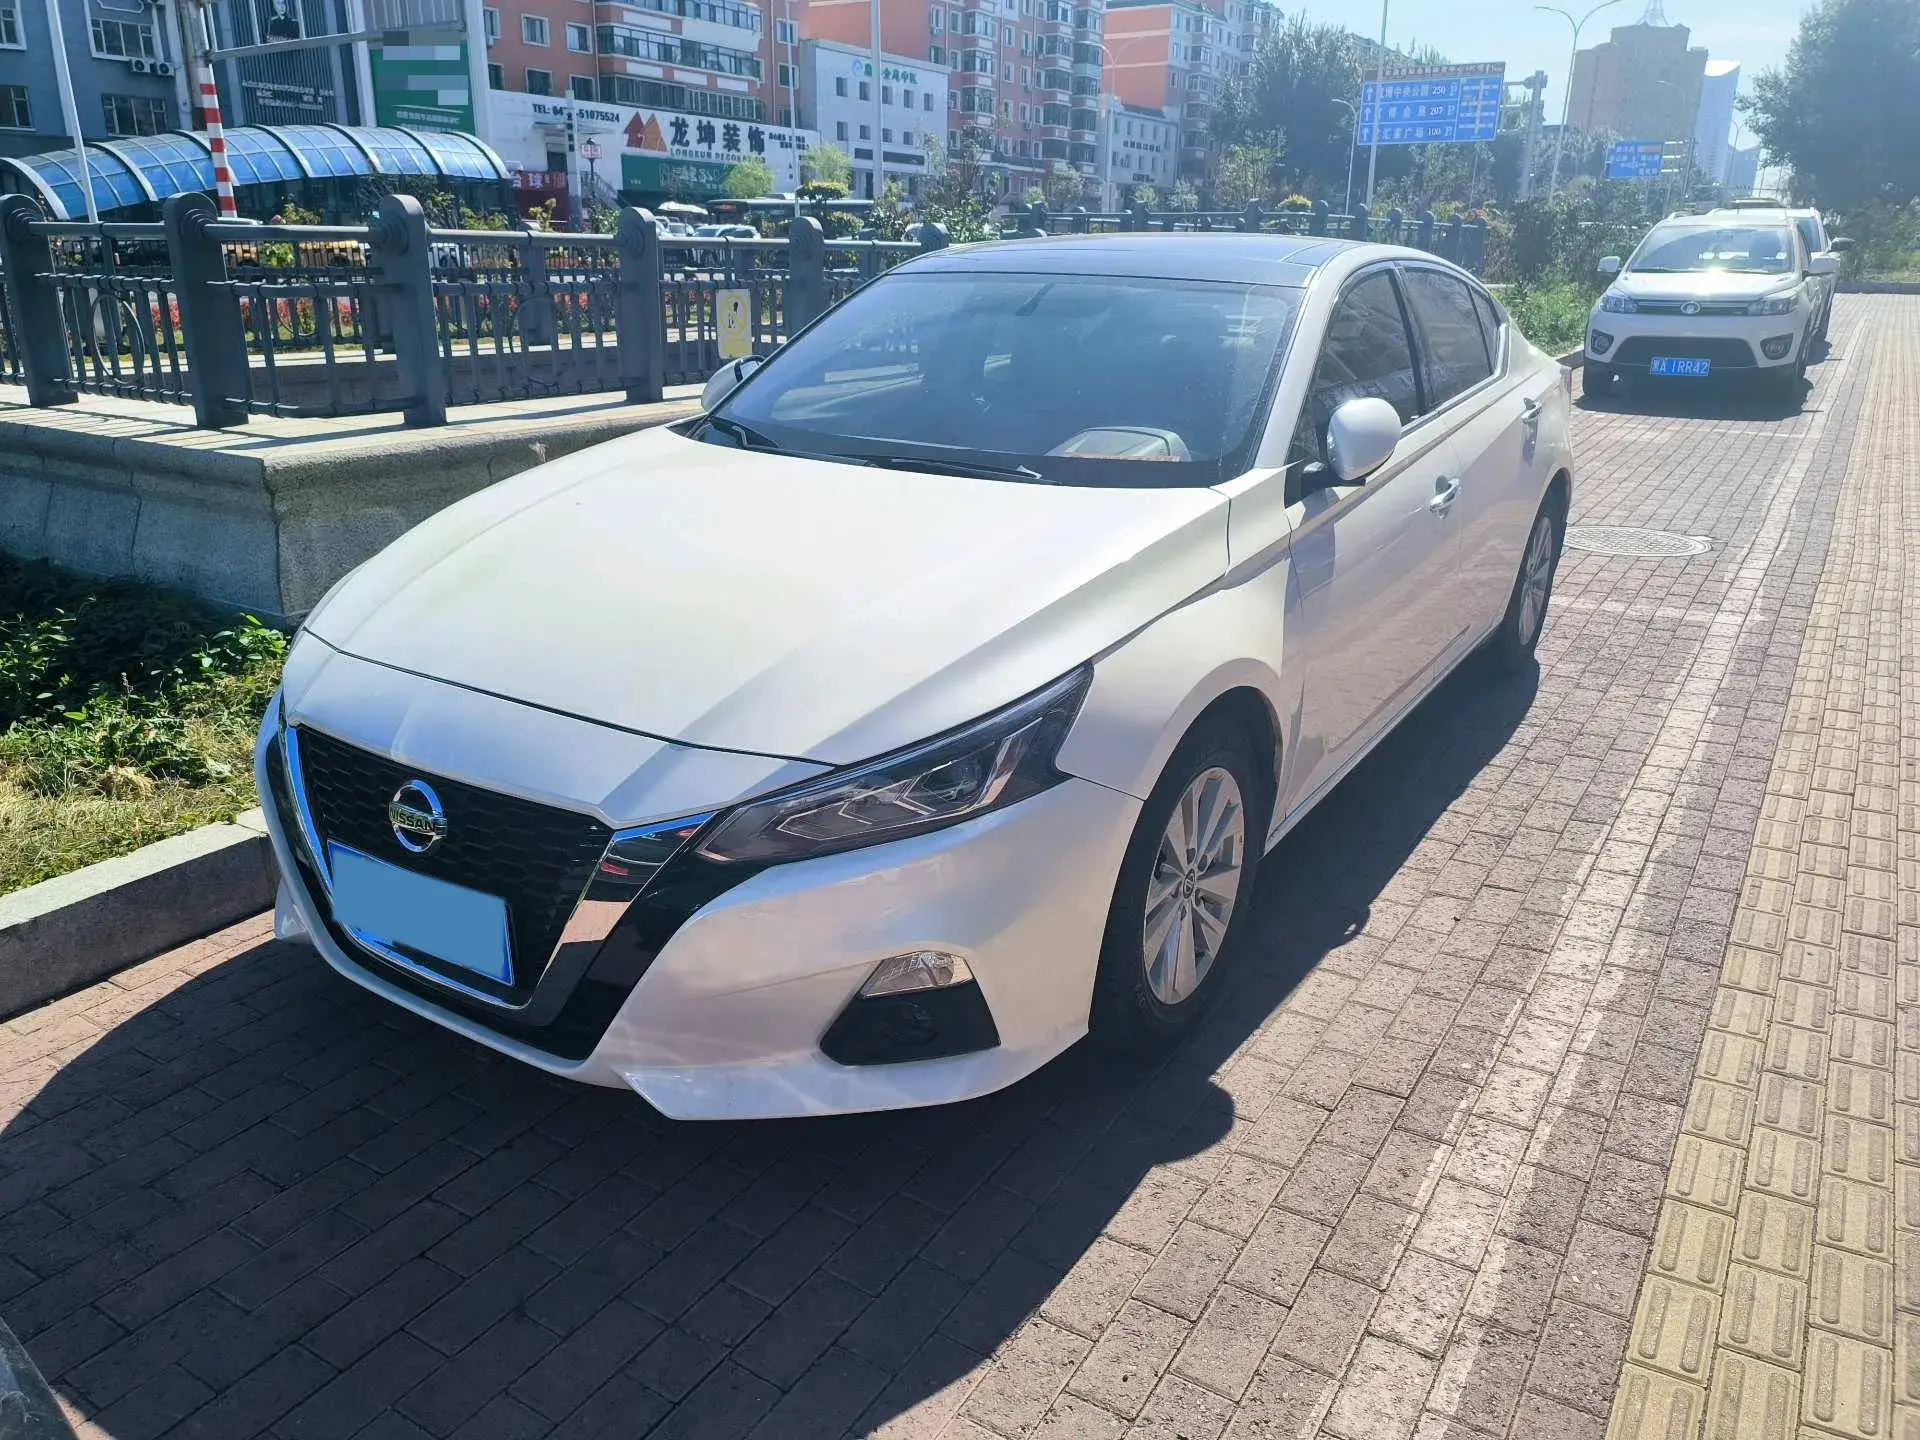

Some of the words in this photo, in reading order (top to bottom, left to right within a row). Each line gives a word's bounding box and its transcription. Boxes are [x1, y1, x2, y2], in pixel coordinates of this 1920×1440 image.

[669, 116, 765, 155] 龙坤装饰
[391, 809, 432, 829] NISSAN
